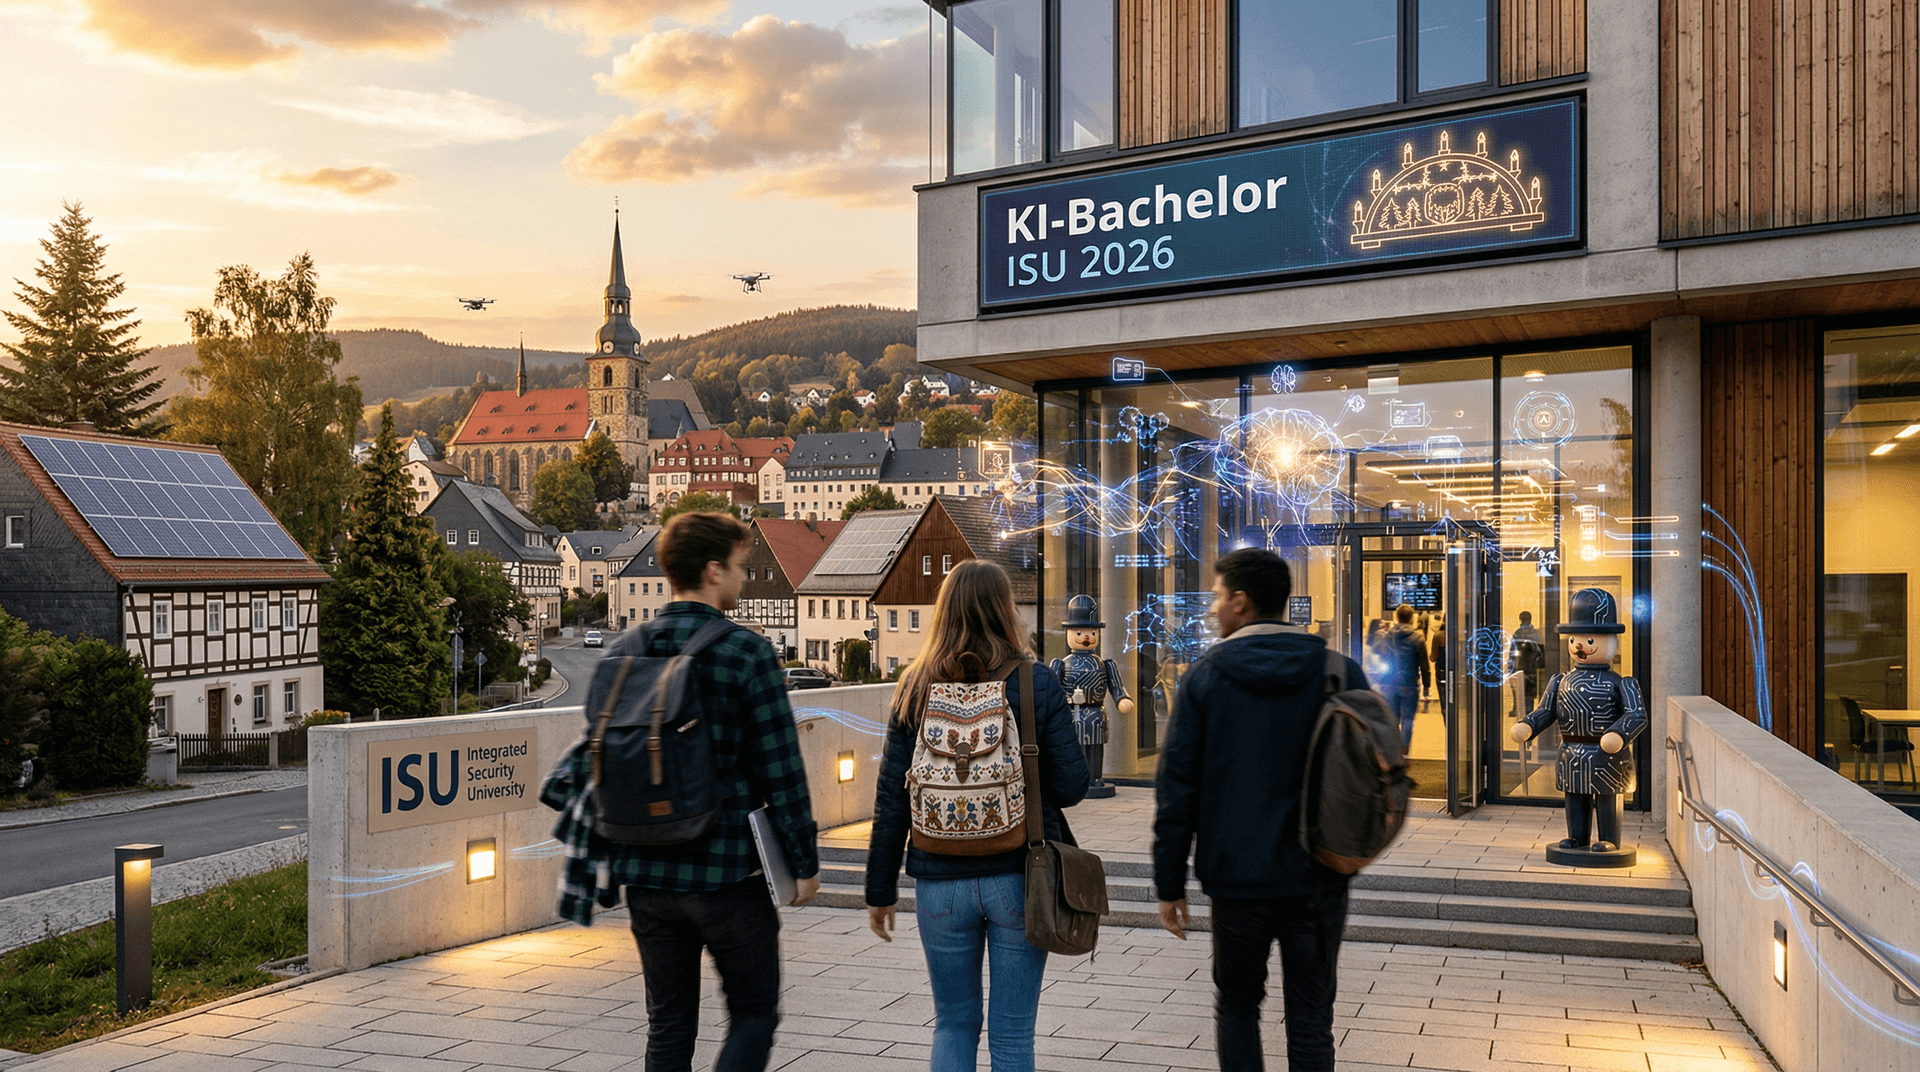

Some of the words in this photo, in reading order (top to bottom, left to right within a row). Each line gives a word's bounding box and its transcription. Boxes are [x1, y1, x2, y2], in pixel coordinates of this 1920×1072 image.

[1008, 174, 1288, 244] KI-Bachelor
[1008, 249, 1067, 287] ISU
[1081, 235, 1175, 279] 2026
[467, 740, 528, 763] Integrated
[381, 749, 460, 815] ISU
[467, 763, 515, 781] Security
[467, 782, 526, 801] University
